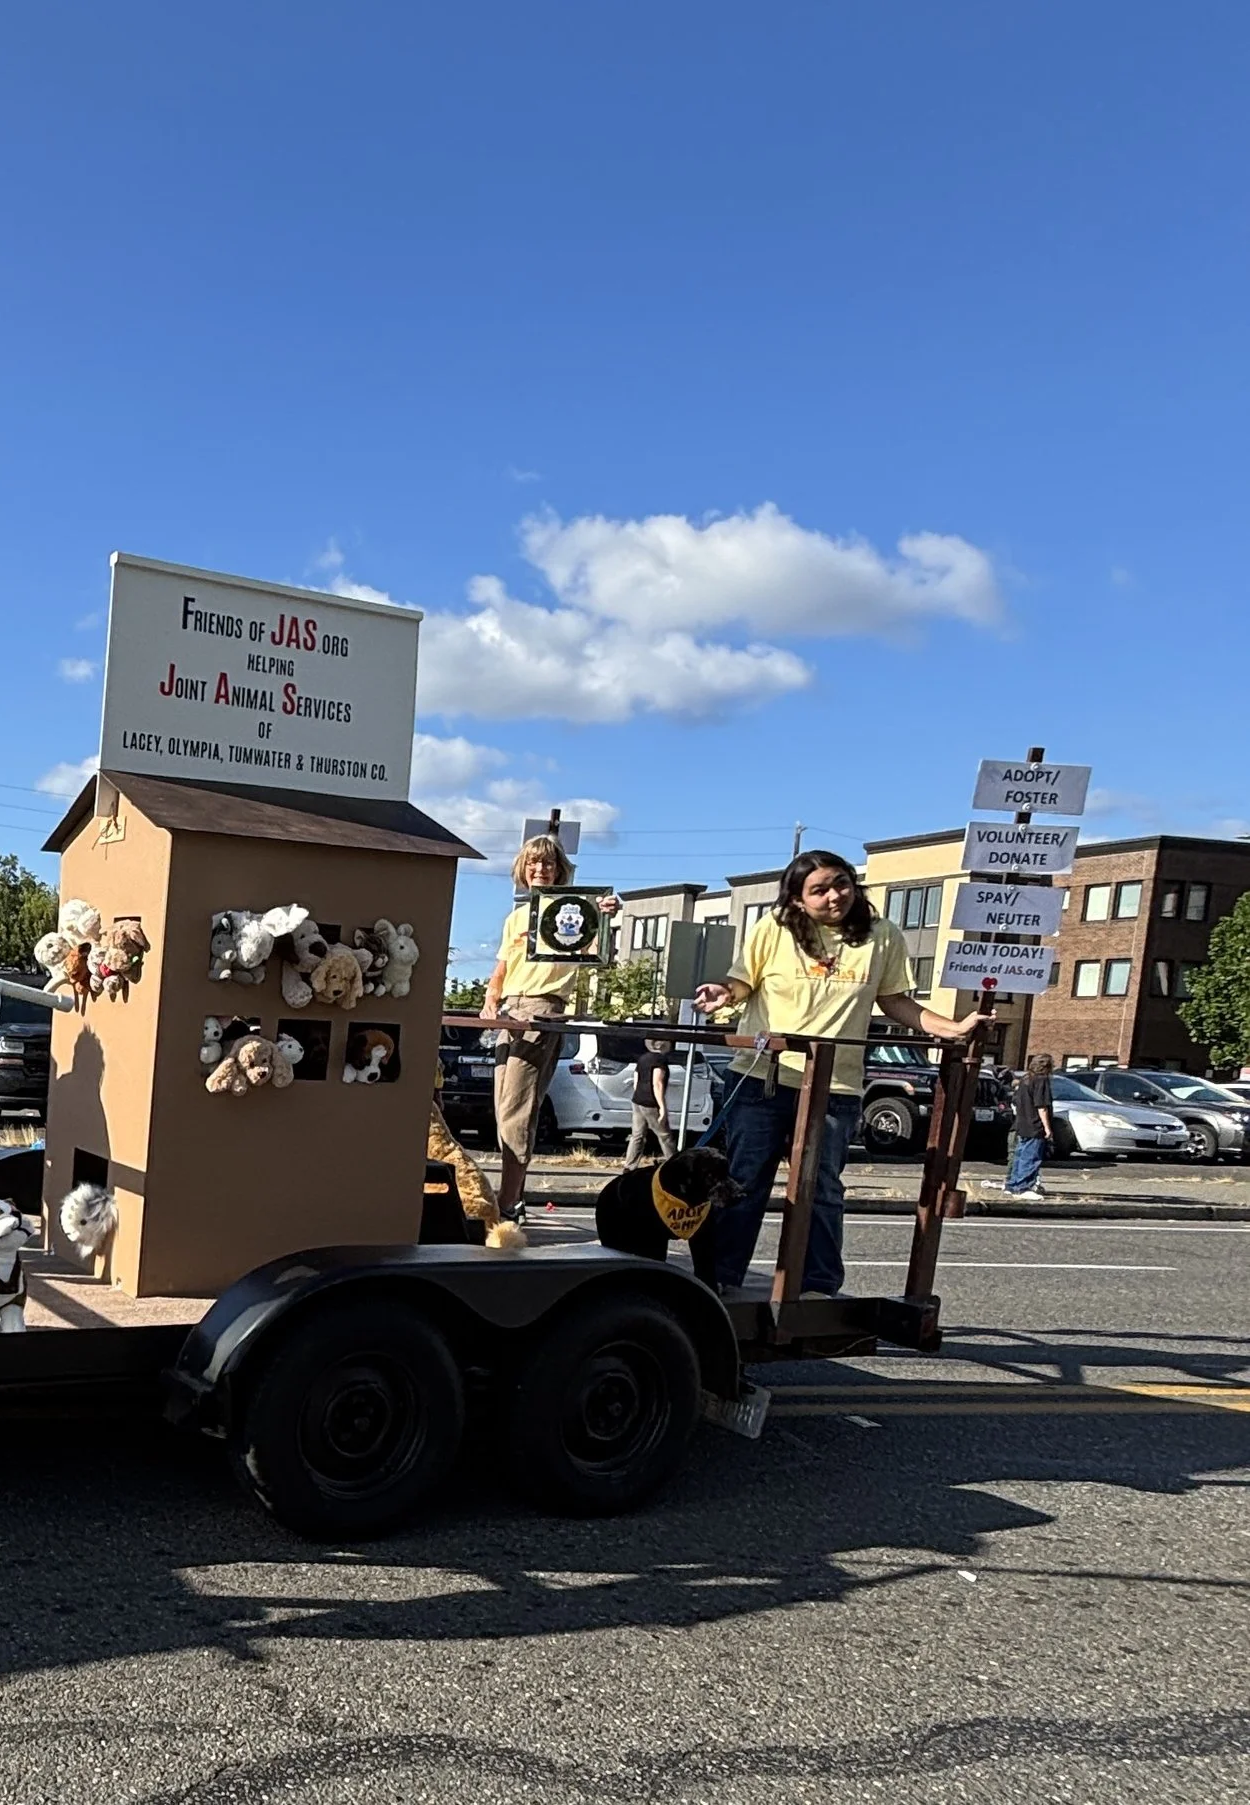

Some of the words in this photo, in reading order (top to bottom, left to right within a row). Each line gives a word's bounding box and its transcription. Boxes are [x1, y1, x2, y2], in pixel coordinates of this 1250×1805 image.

[249, 620, 266, 642] OF
[247, 653, 295, 677] HELPING
[258, 721, 272, 739] OF
[122, 731, 164, 756] LACEY,
[168, 737, 224, 763] OLYMPIA,
[228, 745, 291, 769] TUMWATER
[295, 754, 304, 771] &
[310, 755, 367, 779] THURSTON
[370, 764, 389, 782] CO.
[1002, 769, 1061, 786] ADOPT/
[1005, 790, 1059, 805] FOSTER
[976, 830, 1069, 848] VOLUNTEER/
[988, 852, 1048, 866] DONATE
[976, 891, 1020, 906] SPAY/
[986, 912, 1041, 927] NEUTER
[955, 942, 989, 957] JOIN
[991, 945, 1044, 960] TODAY!
[949, 961, 988, 974] Friends
[990, 964, 1003, 974] of
[1003, 965, 1044, 979] JAS.org
